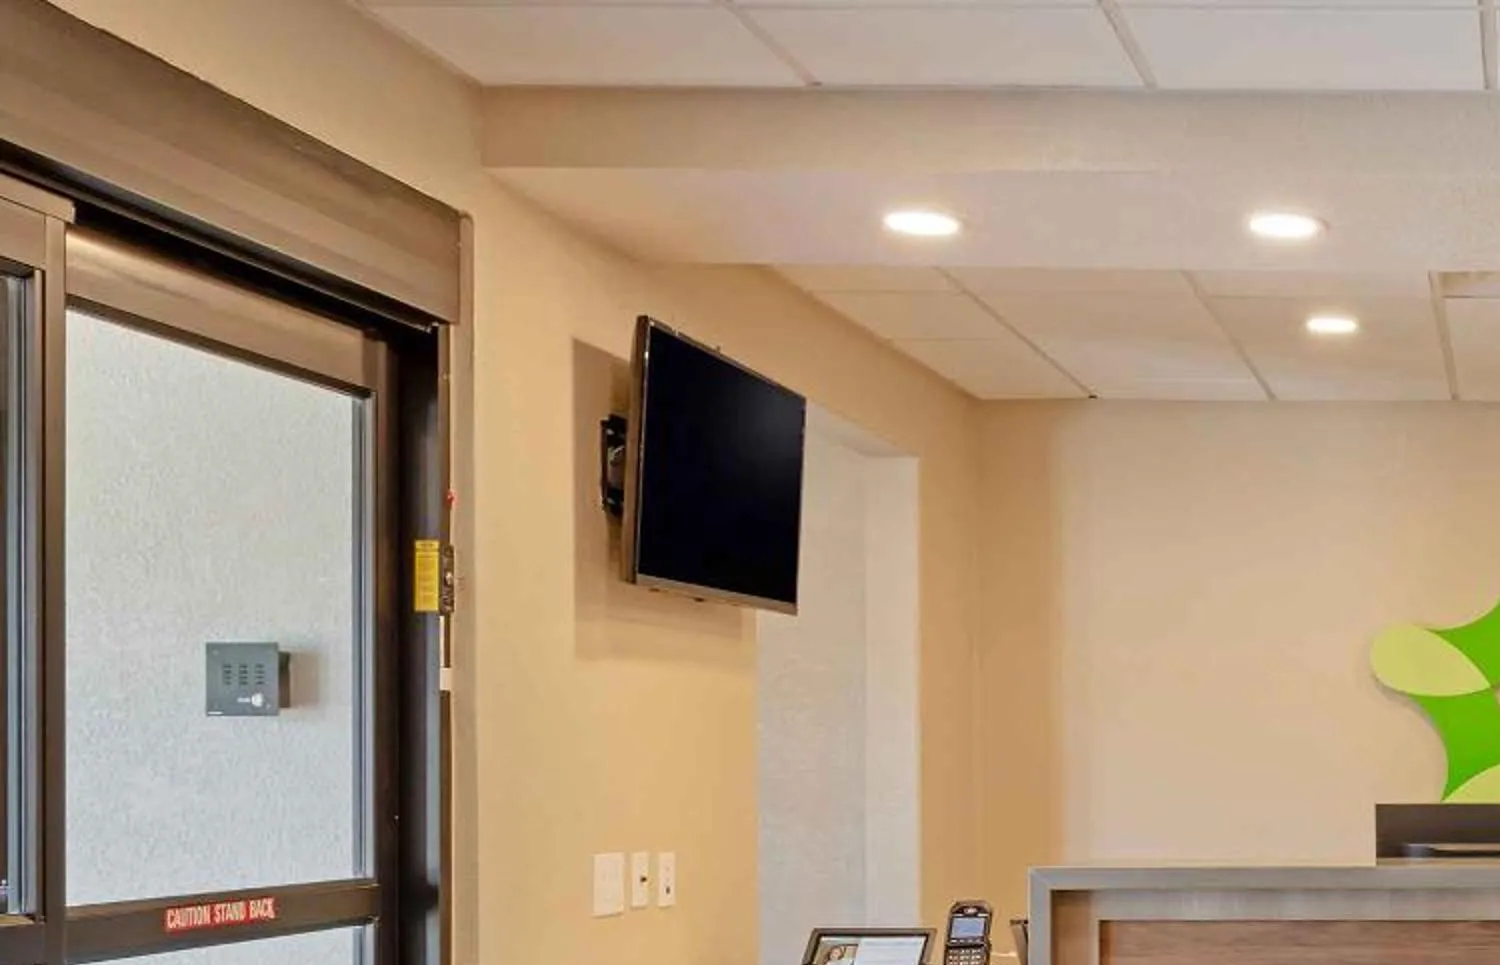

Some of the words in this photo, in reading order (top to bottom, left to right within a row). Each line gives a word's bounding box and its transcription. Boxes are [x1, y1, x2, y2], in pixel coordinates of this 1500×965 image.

[166, 904, 211, 929] CAUTION
[213, 901, 246, 923] STAND
[249, 898, 275, 919] BACK
